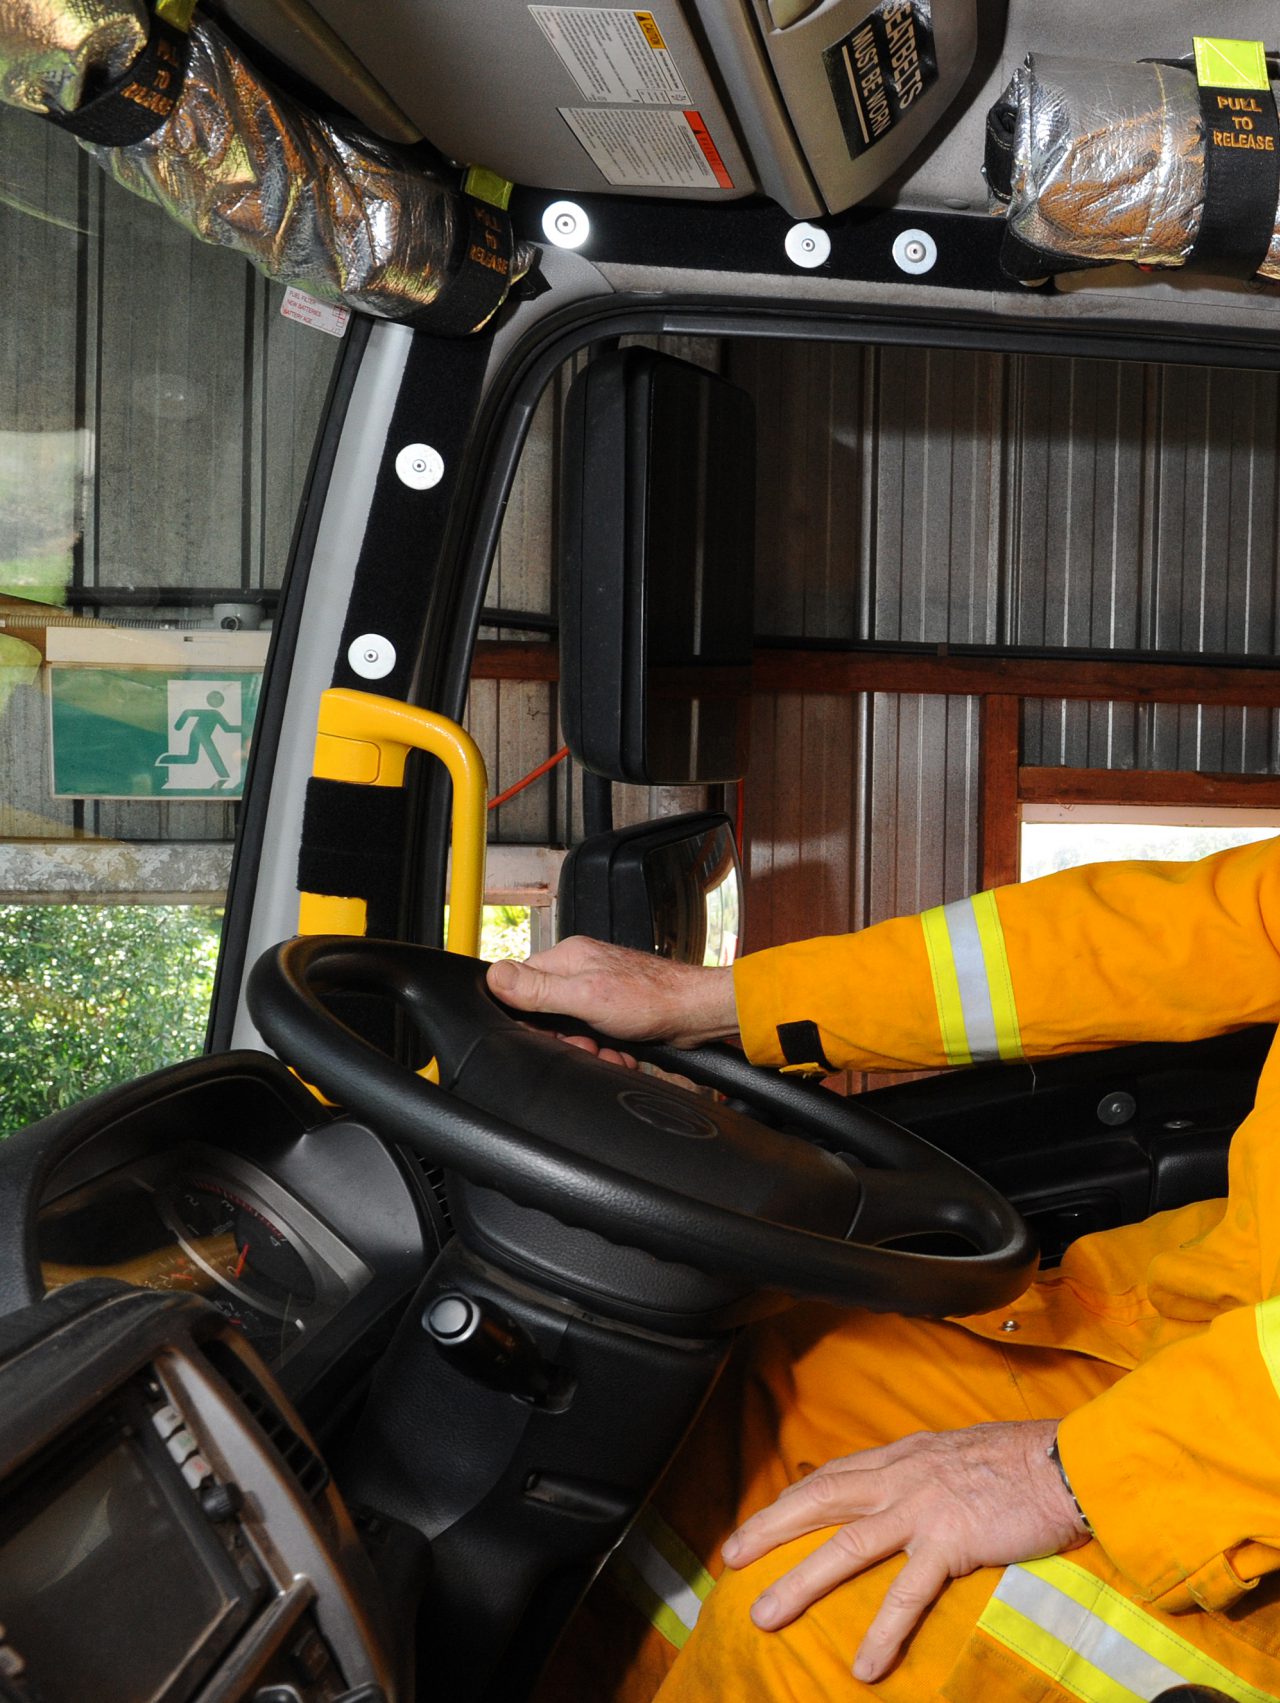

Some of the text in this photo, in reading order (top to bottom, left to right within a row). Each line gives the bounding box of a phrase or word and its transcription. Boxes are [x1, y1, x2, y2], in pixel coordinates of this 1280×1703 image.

[883, 0, 923, 109] SEATBELTS
[852, 24, 891, 136] MUST BE WORN
[1217, 96, 1262, 112] PULL
[1232, 116, 1253, 130] TO
[1213, 130, 1275, 151] RELEASE
